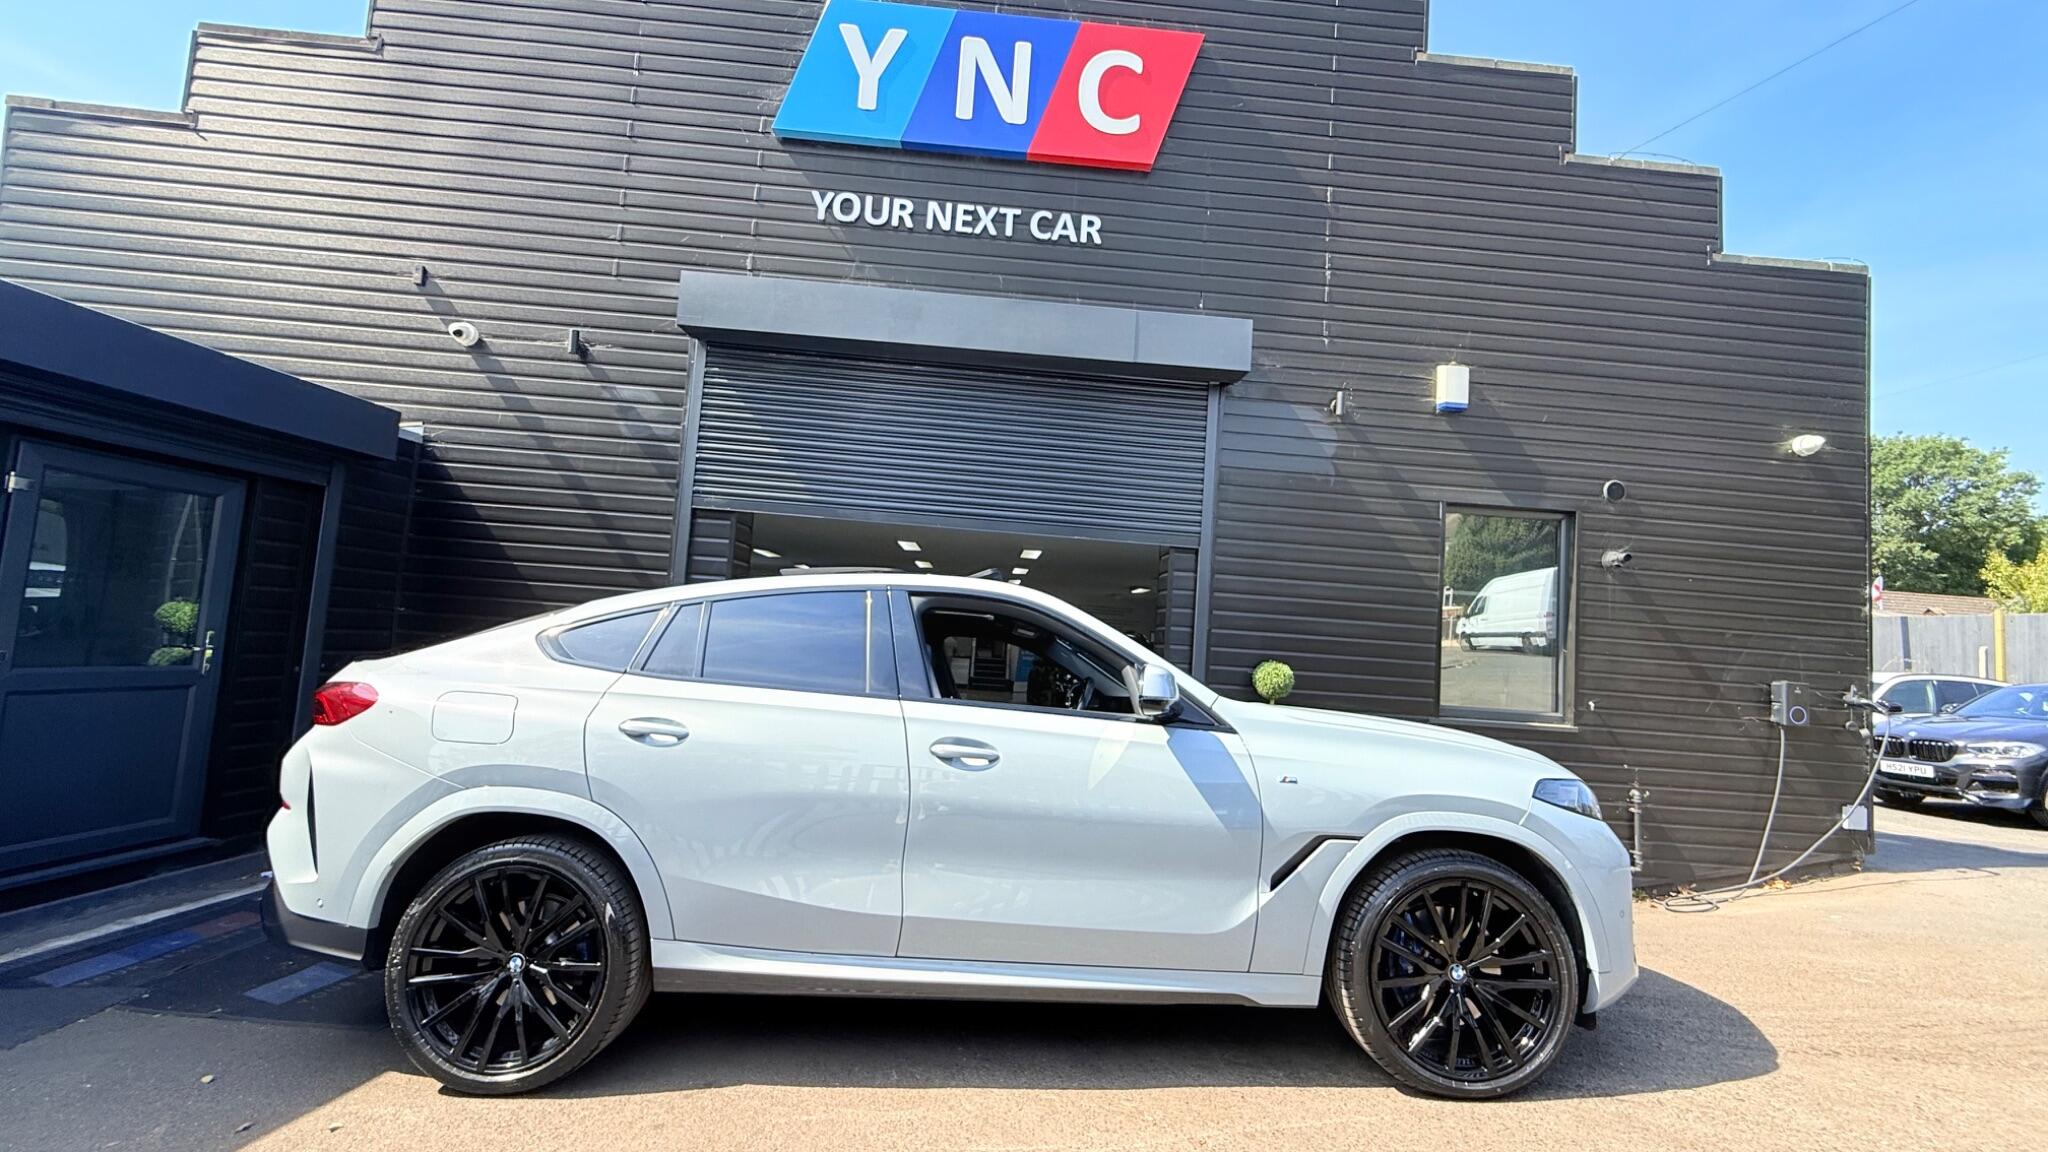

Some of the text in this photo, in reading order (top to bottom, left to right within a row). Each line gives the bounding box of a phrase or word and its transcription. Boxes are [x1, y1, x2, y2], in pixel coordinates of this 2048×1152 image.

[838, 23, 1144, 135] YNC
[811, 190, 1102, 245] YOUR NEXT CAR
[1908, 766, 1927, 775] YPU
